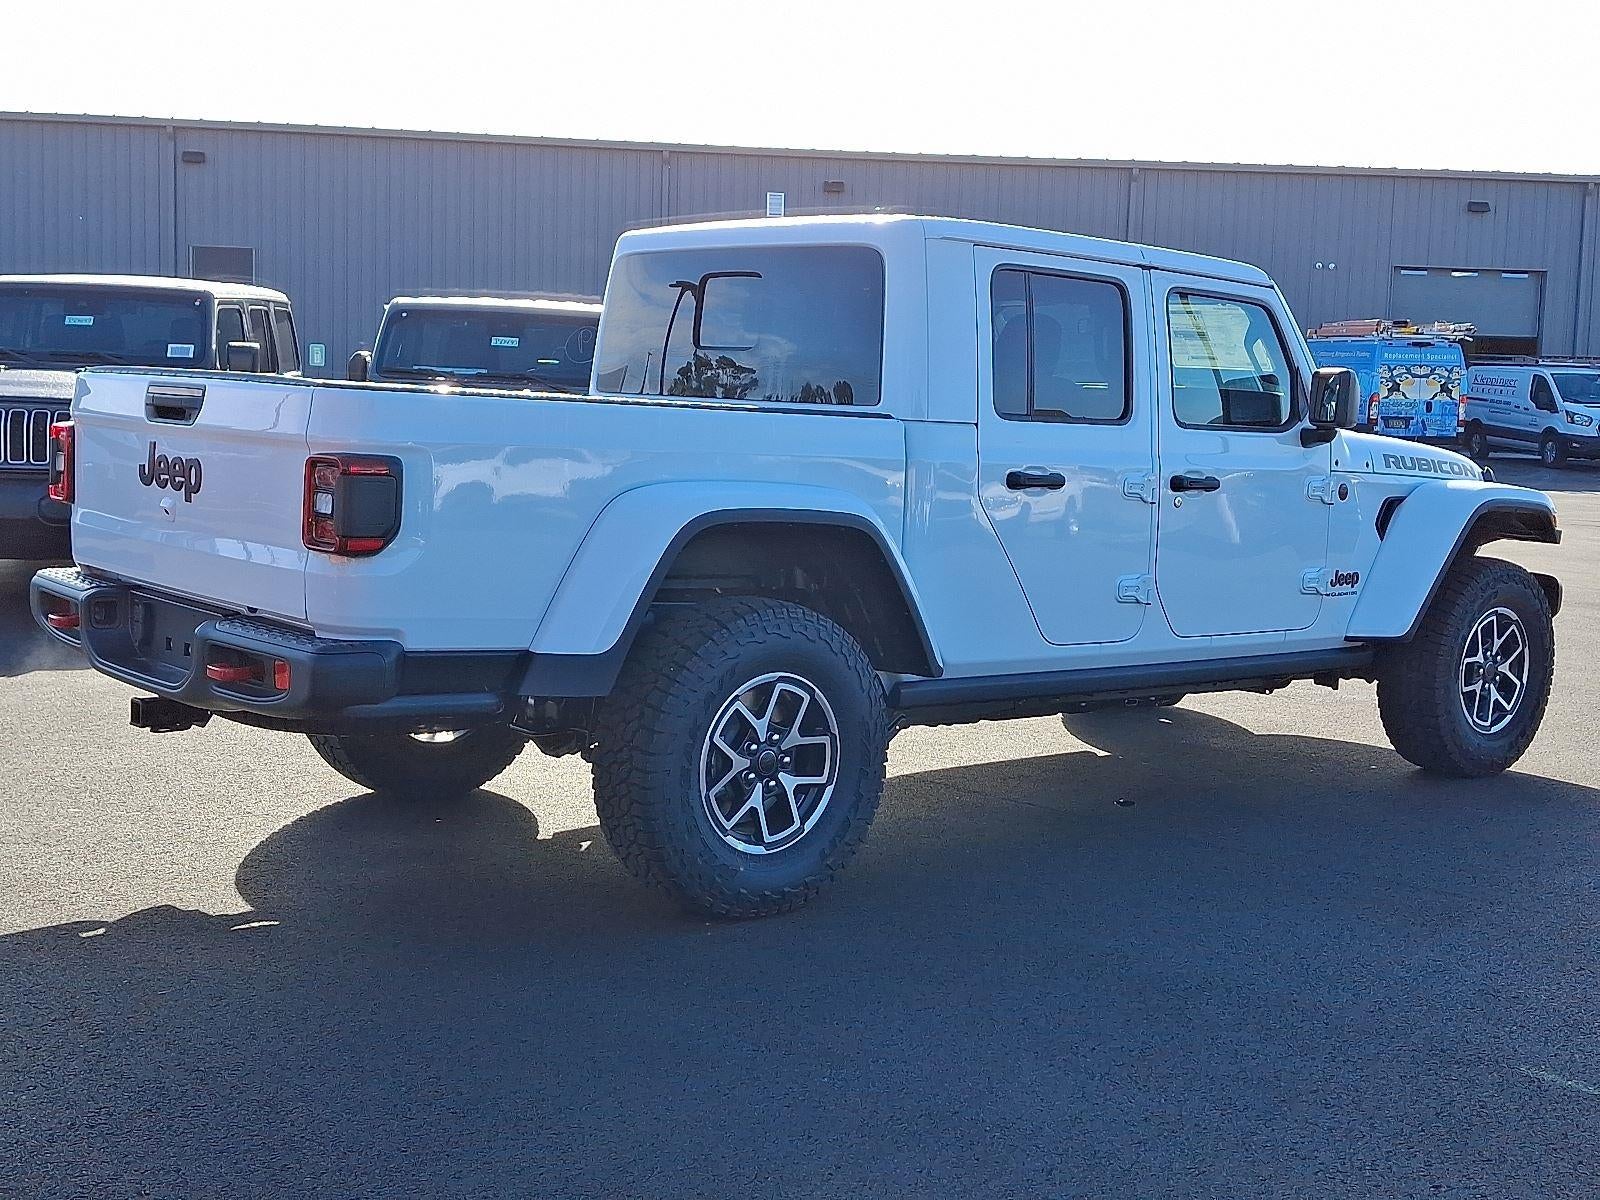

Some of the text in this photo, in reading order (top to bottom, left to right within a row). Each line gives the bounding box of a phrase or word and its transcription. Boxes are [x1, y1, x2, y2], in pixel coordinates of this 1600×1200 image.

[1384, 352, 1426, 360] Replacement
[1472, 374, 1519, 388] Kleppinger
[138, 440, 203, 504] Jeep
[1383, 454, 1477, 478] RUBICON
[1330, 570, 1359, 588] Jeep
